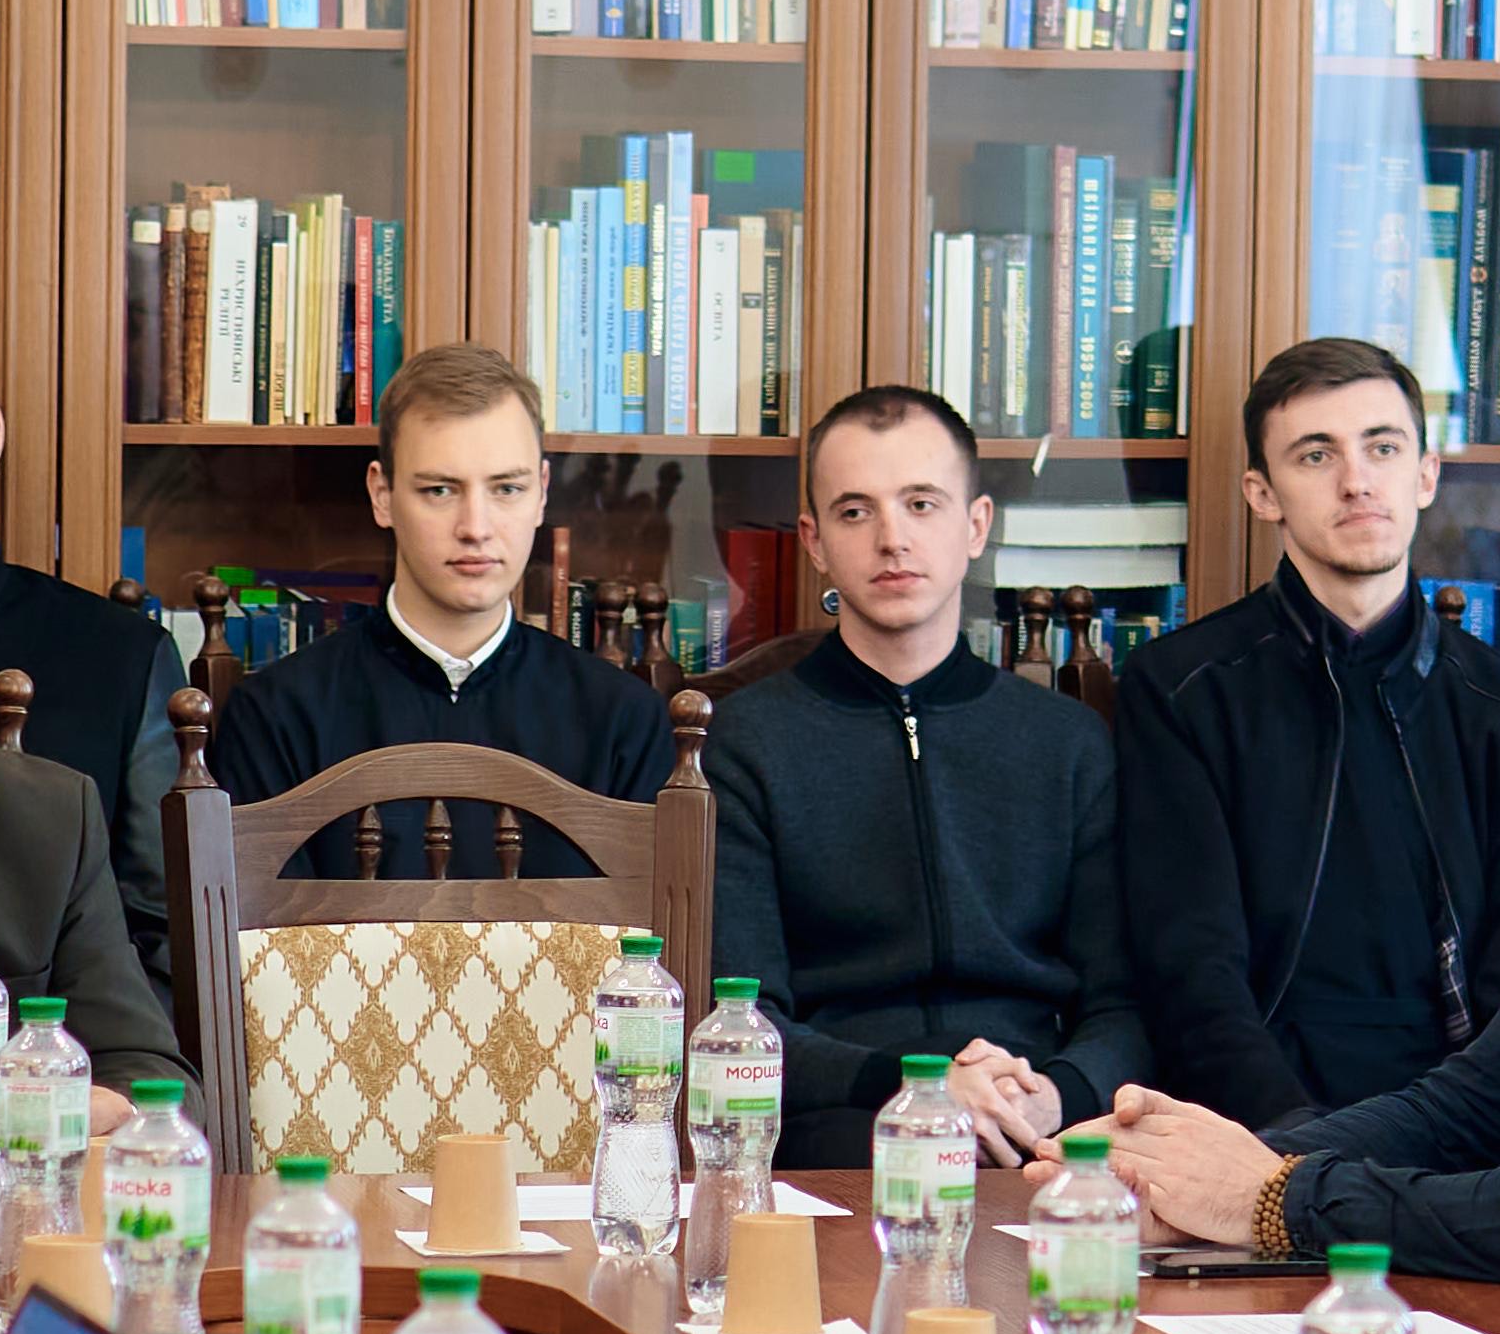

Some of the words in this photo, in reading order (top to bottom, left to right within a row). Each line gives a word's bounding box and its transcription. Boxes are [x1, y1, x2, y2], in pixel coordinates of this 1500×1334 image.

[1082, 177, 1101, 256] ШКІЛЬНА
[670, 226, 685, 289] УКРАЇНИ
[1080, 264, 1100, 309] РАДА
[231, 259, 247, 384] НЕХРИСТИЯНСЬКІ
[670, 294, 685, 349] ГАЛУЗЬ
[712, 291, 725, 342] ОСВІТА
[669, 354, 684, 411] ГАЗОВА
